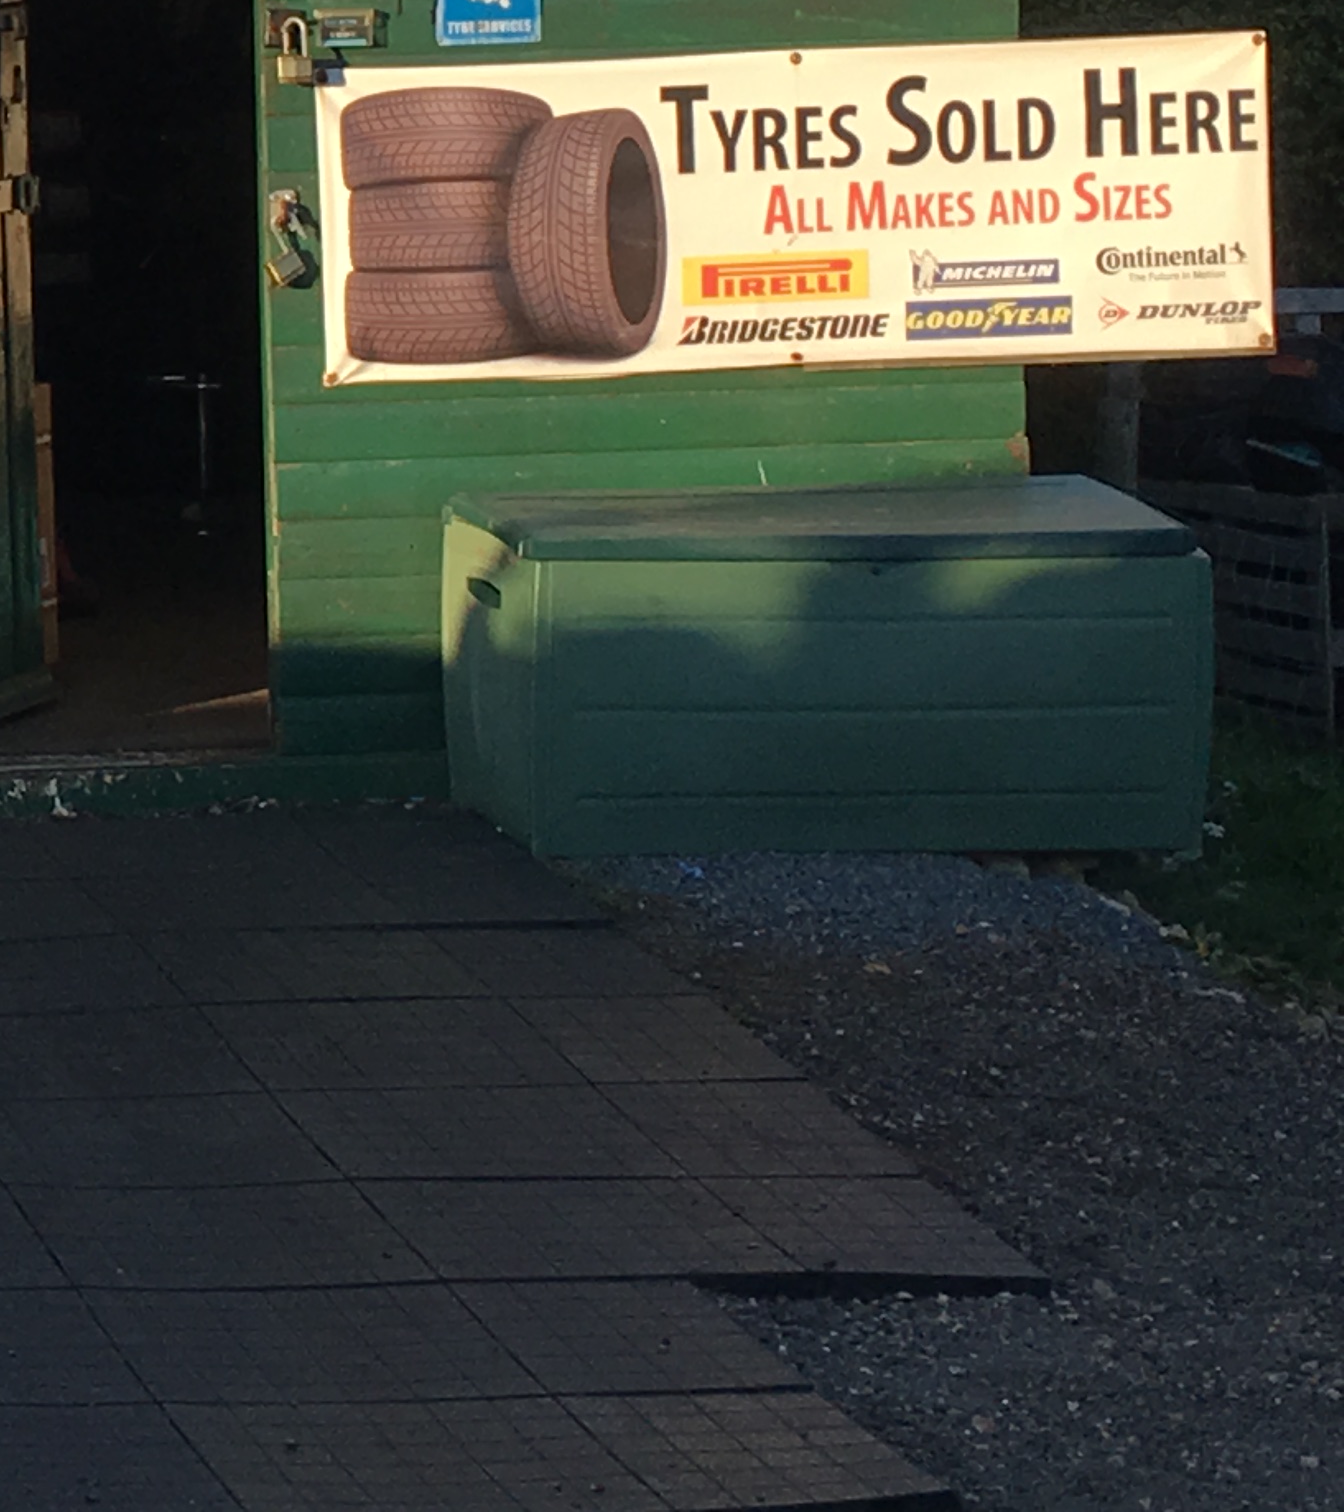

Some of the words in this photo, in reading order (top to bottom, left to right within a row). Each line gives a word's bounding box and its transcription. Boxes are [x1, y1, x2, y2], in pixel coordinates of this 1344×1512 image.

[447, 19, 475, 35] TYRE
[659, 83, 862, 175] TYRES
[885, 74, 1056, 167] SOLD
[1083, 67, 1259, 158] HERE
[763, 184, 833, 235] ALL
[846, 180, 976, 232] MAKES
[987, 188, 1061, 226] AND
[1073, 171, 1173, 223] SIZES
[940, 262, 1055, 282] MICHELIN
[1096, 242, 1226, 276] Continental
[701, 258, 853, 298] PIRELLI
[906, 303, 1072, 332] GOODYEAR
[1136, 301, 1262, 320] DUNLOP
[676, 313, 890, 346] BRIDGESTONE
